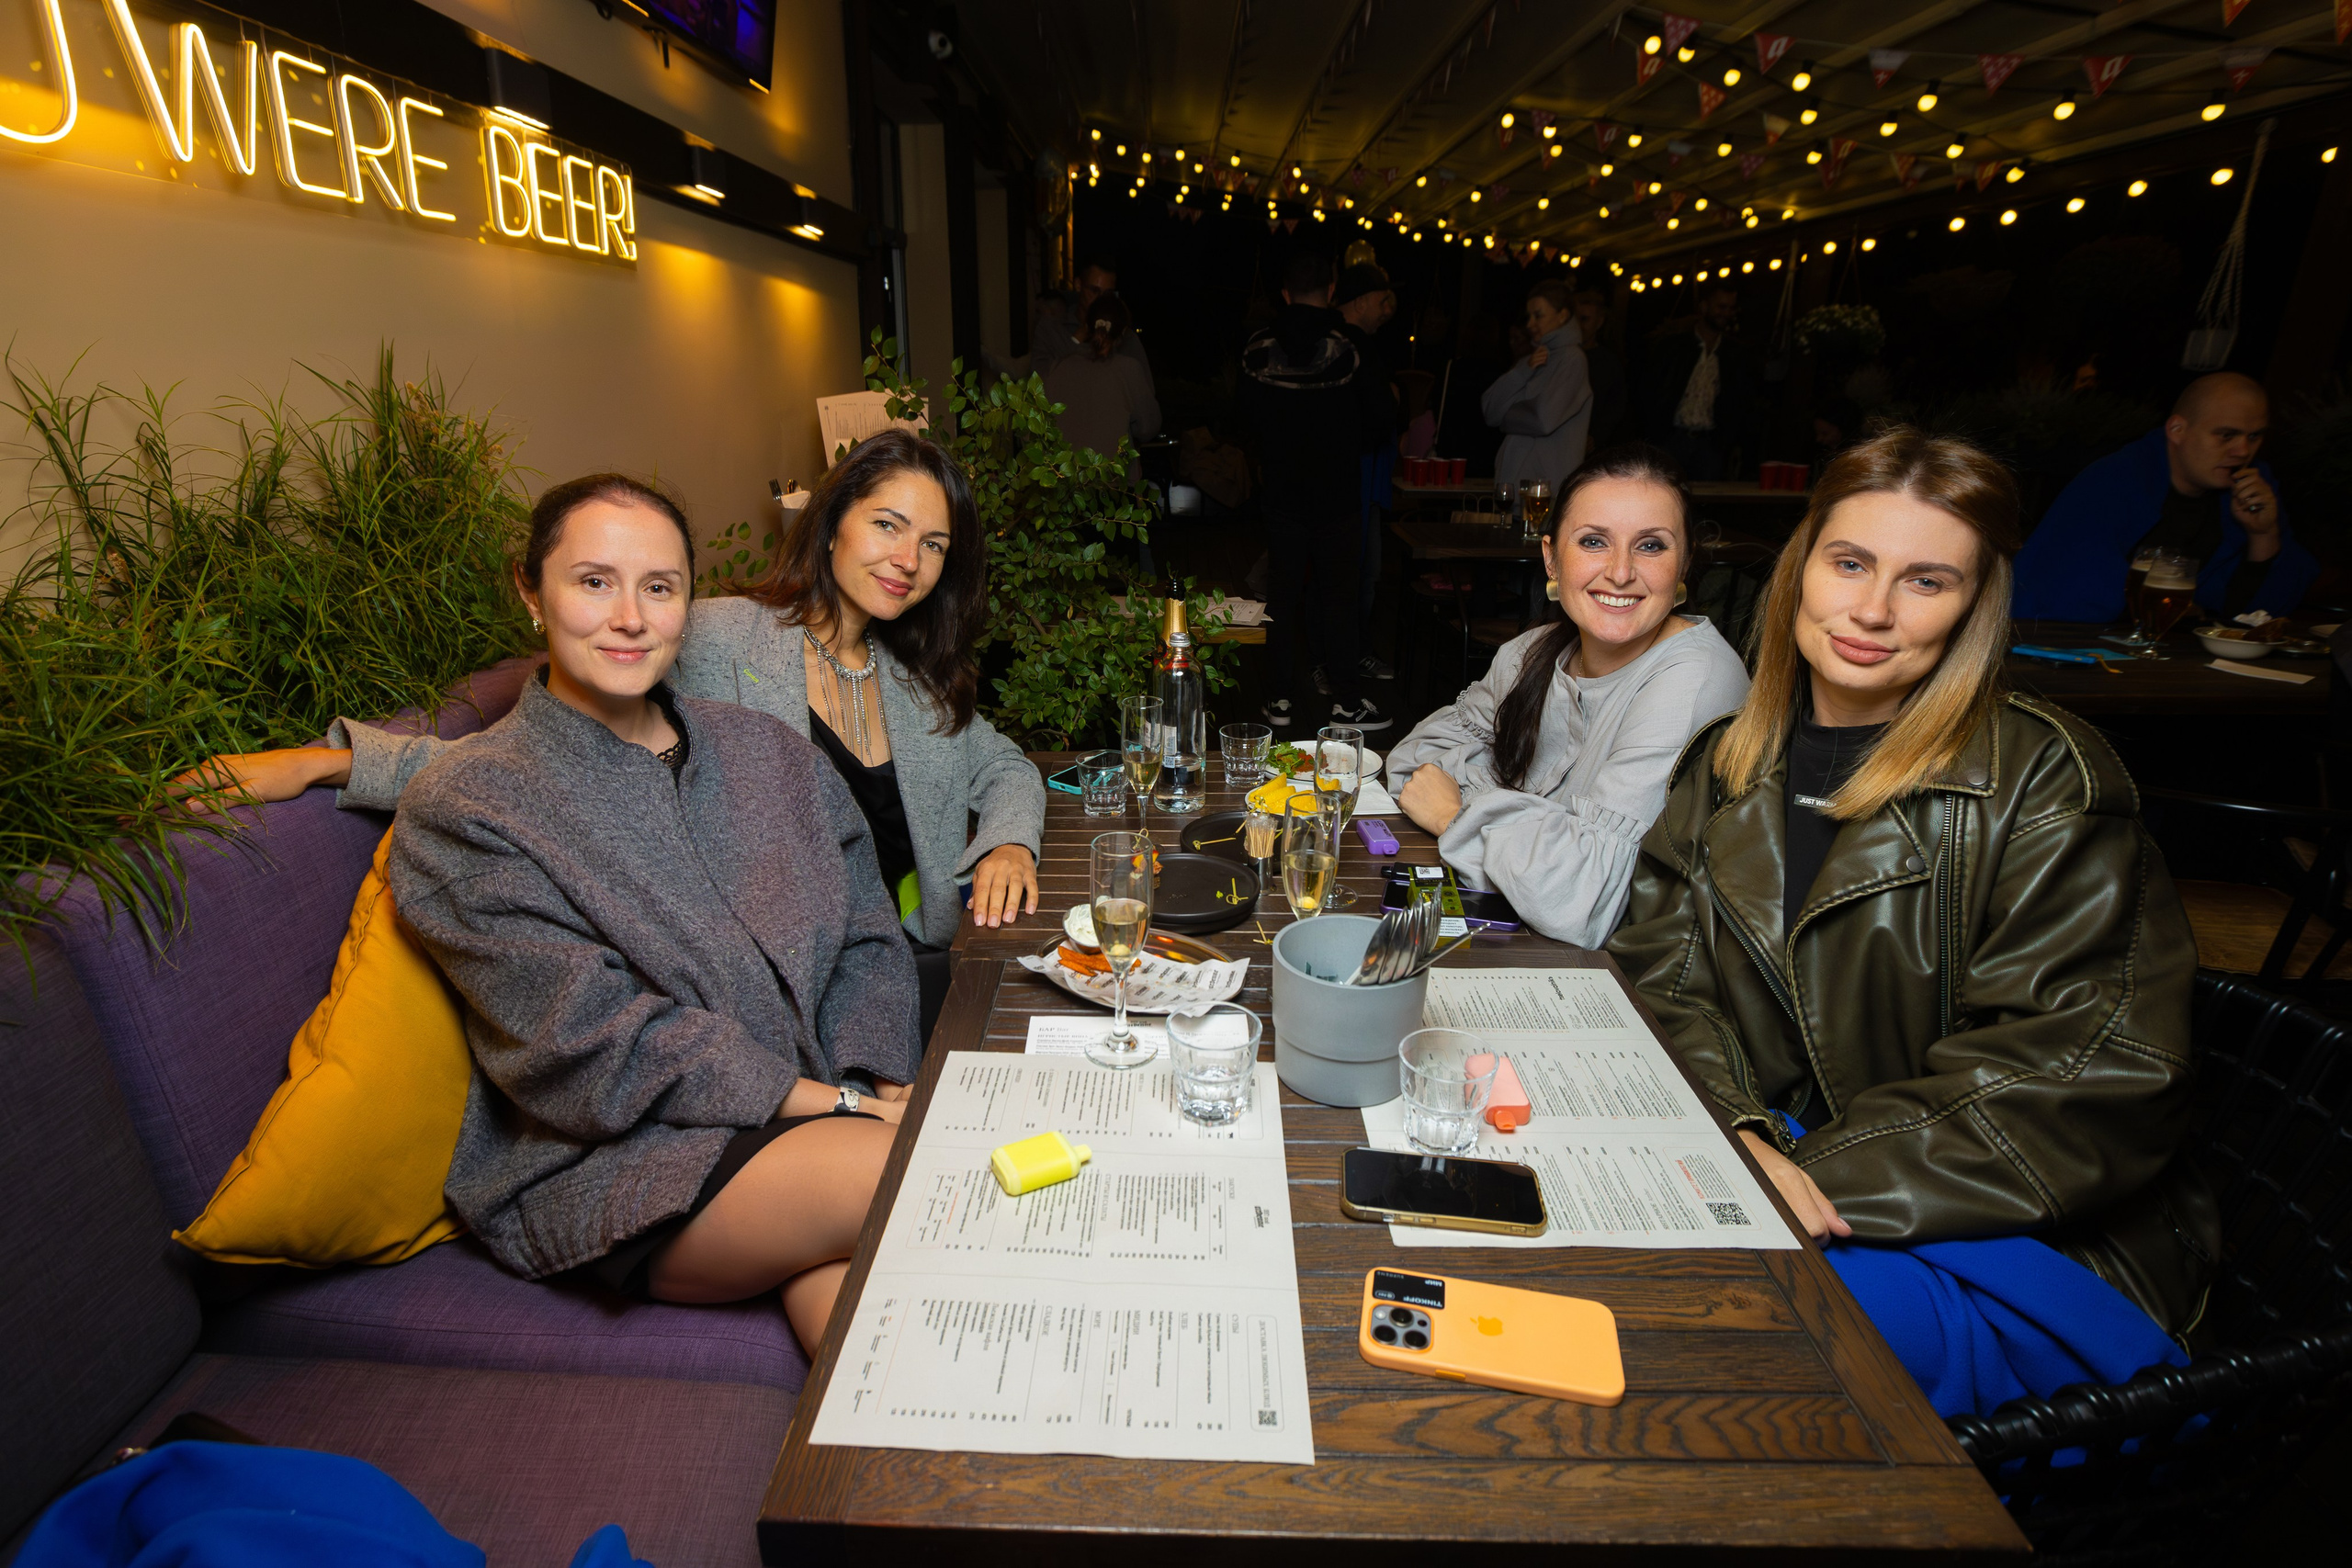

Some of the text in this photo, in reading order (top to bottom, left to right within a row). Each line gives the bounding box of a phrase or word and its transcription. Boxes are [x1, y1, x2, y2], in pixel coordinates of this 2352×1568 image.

[99, 0, 458, 223] WERE
[481, 123, 638, 262] BEER!
[1799, 796, 1815, 806] JUST
[1376, 1271, 1405, 1280] SUPREME
[1424, 1279, 1442, 1287] МИР
[1402, 1295, 1442, 1308] TINKOFF
[1041, 1305, 1053, 1337] СЛАДКОЕ
[1092, 1311, 1102, 1329] МОРЕ
[1231, 1314, 1239, 1334] СУПЫ
